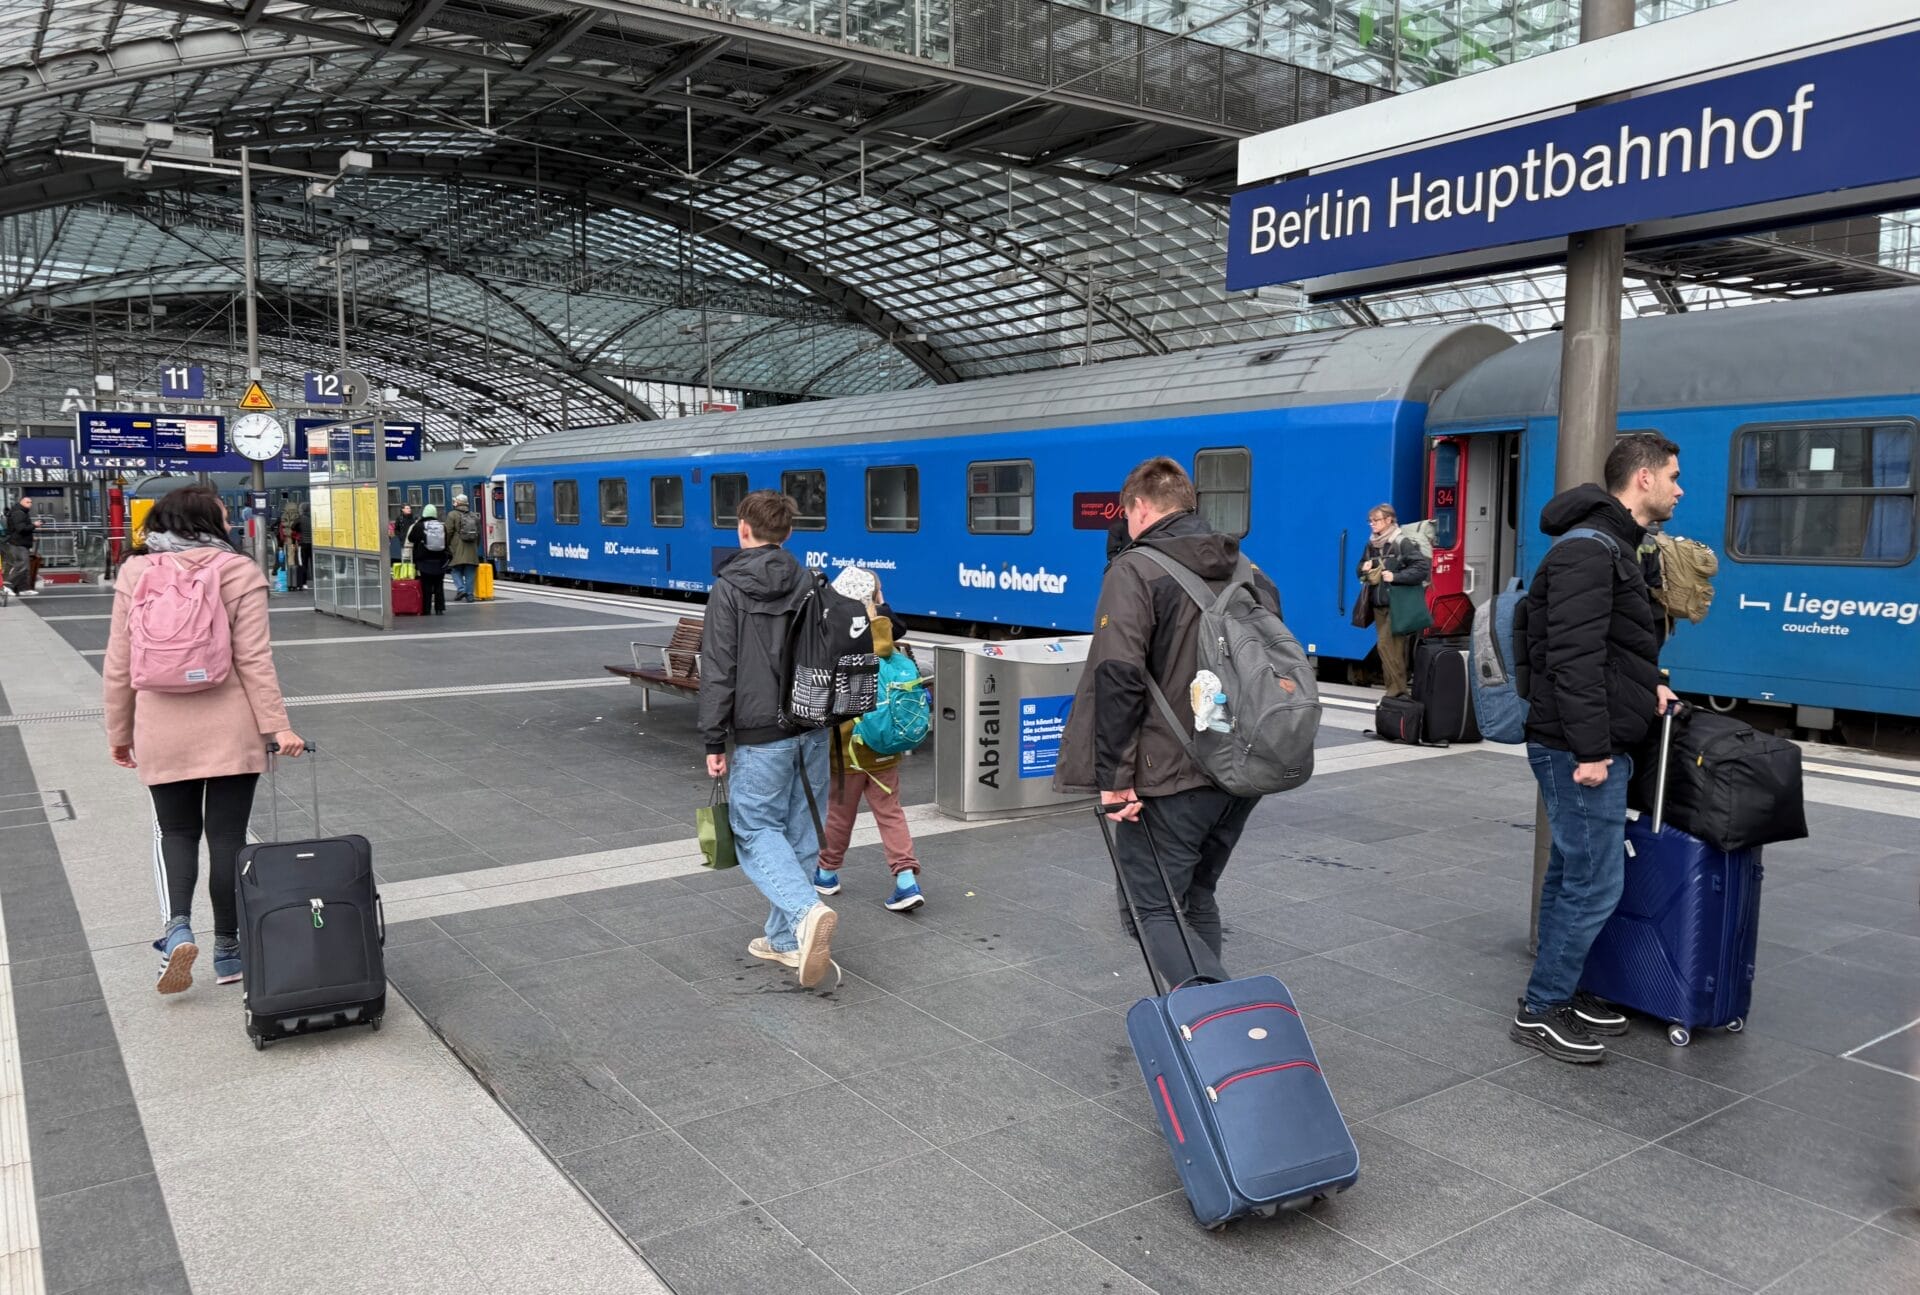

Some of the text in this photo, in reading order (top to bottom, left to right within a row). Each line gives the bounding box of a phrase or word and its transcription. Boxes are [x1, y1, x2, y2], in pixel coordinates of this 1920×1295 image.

[1250, 83, 1816, 255] Berlin Hauptbahnhof
[165, 367, 189, 391] 11
[312, 374, 339, 396] 12
[1437, 490, 1454, 504] 34
[604, 541, 618, 555] RDC
[805, 551, 829, 568] RDC
[857, 557, 866, 567] die
[959, 562, 1068, 594] train charter
[1783, 591, 1920, 625] Liegewag
[1782, 622, 1850, 636] couchette
[978, 700, 1000, 789] Abfall
